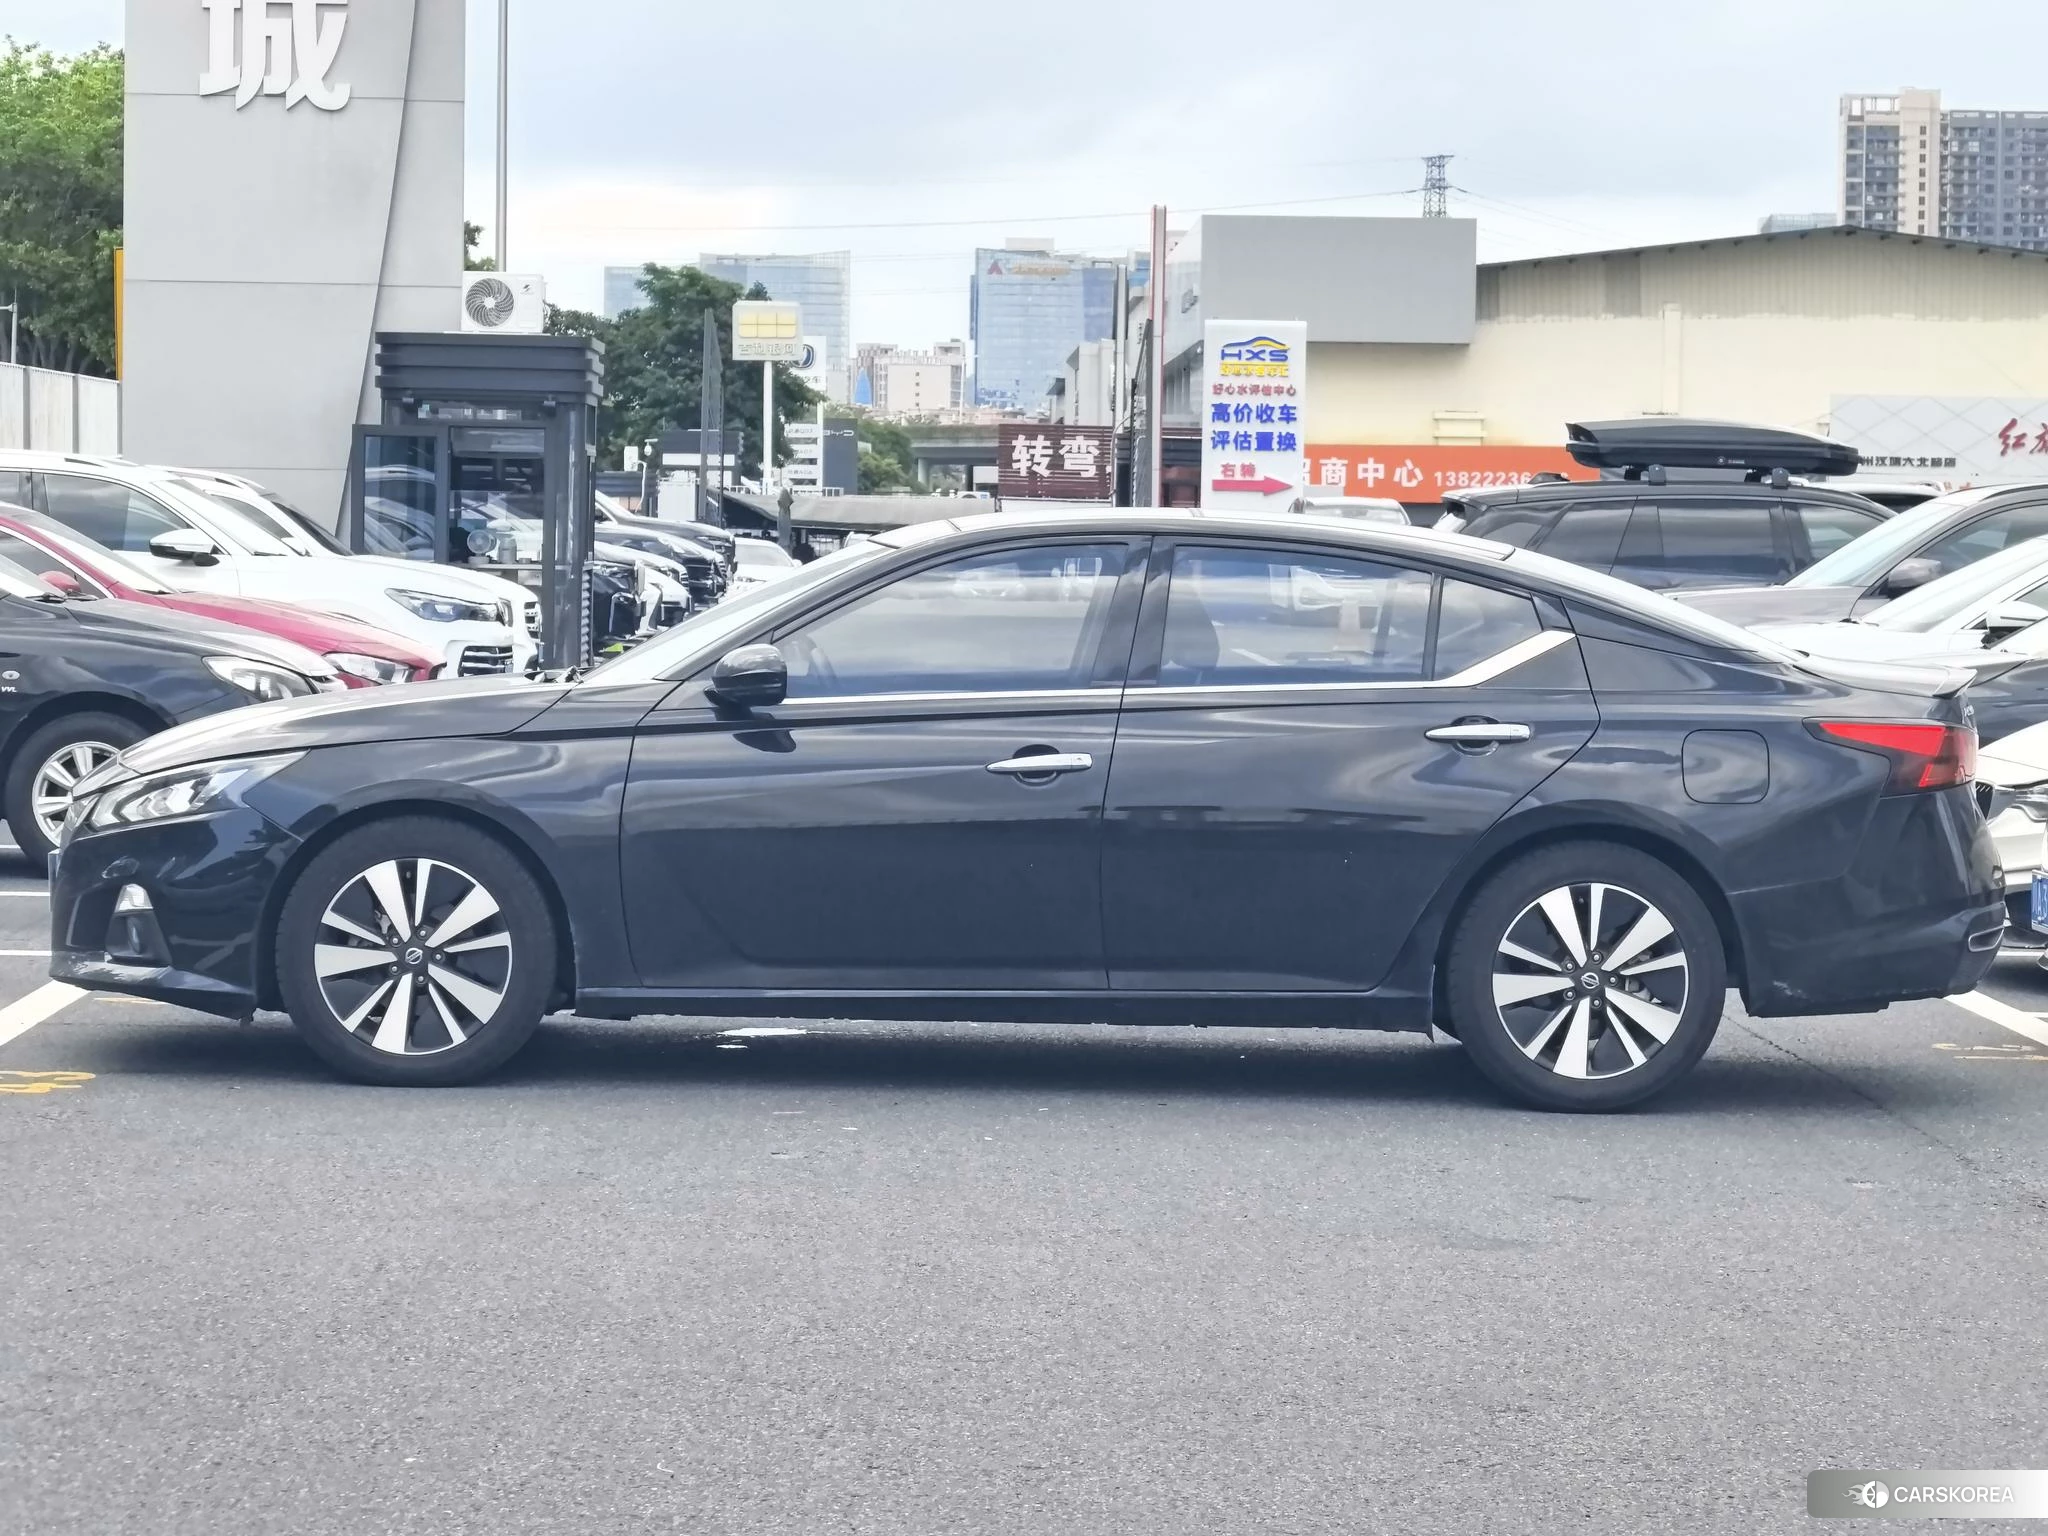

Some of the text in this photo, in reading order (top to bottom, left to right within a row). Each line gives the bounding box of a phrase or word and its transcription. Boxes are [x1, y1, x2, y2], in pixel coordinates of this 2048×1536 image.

[1221, 349, 1289, 362] HXS
[1211, 402, 1298, 424] 高价收车
[1210, 429, 1297, 452] 评估置换
